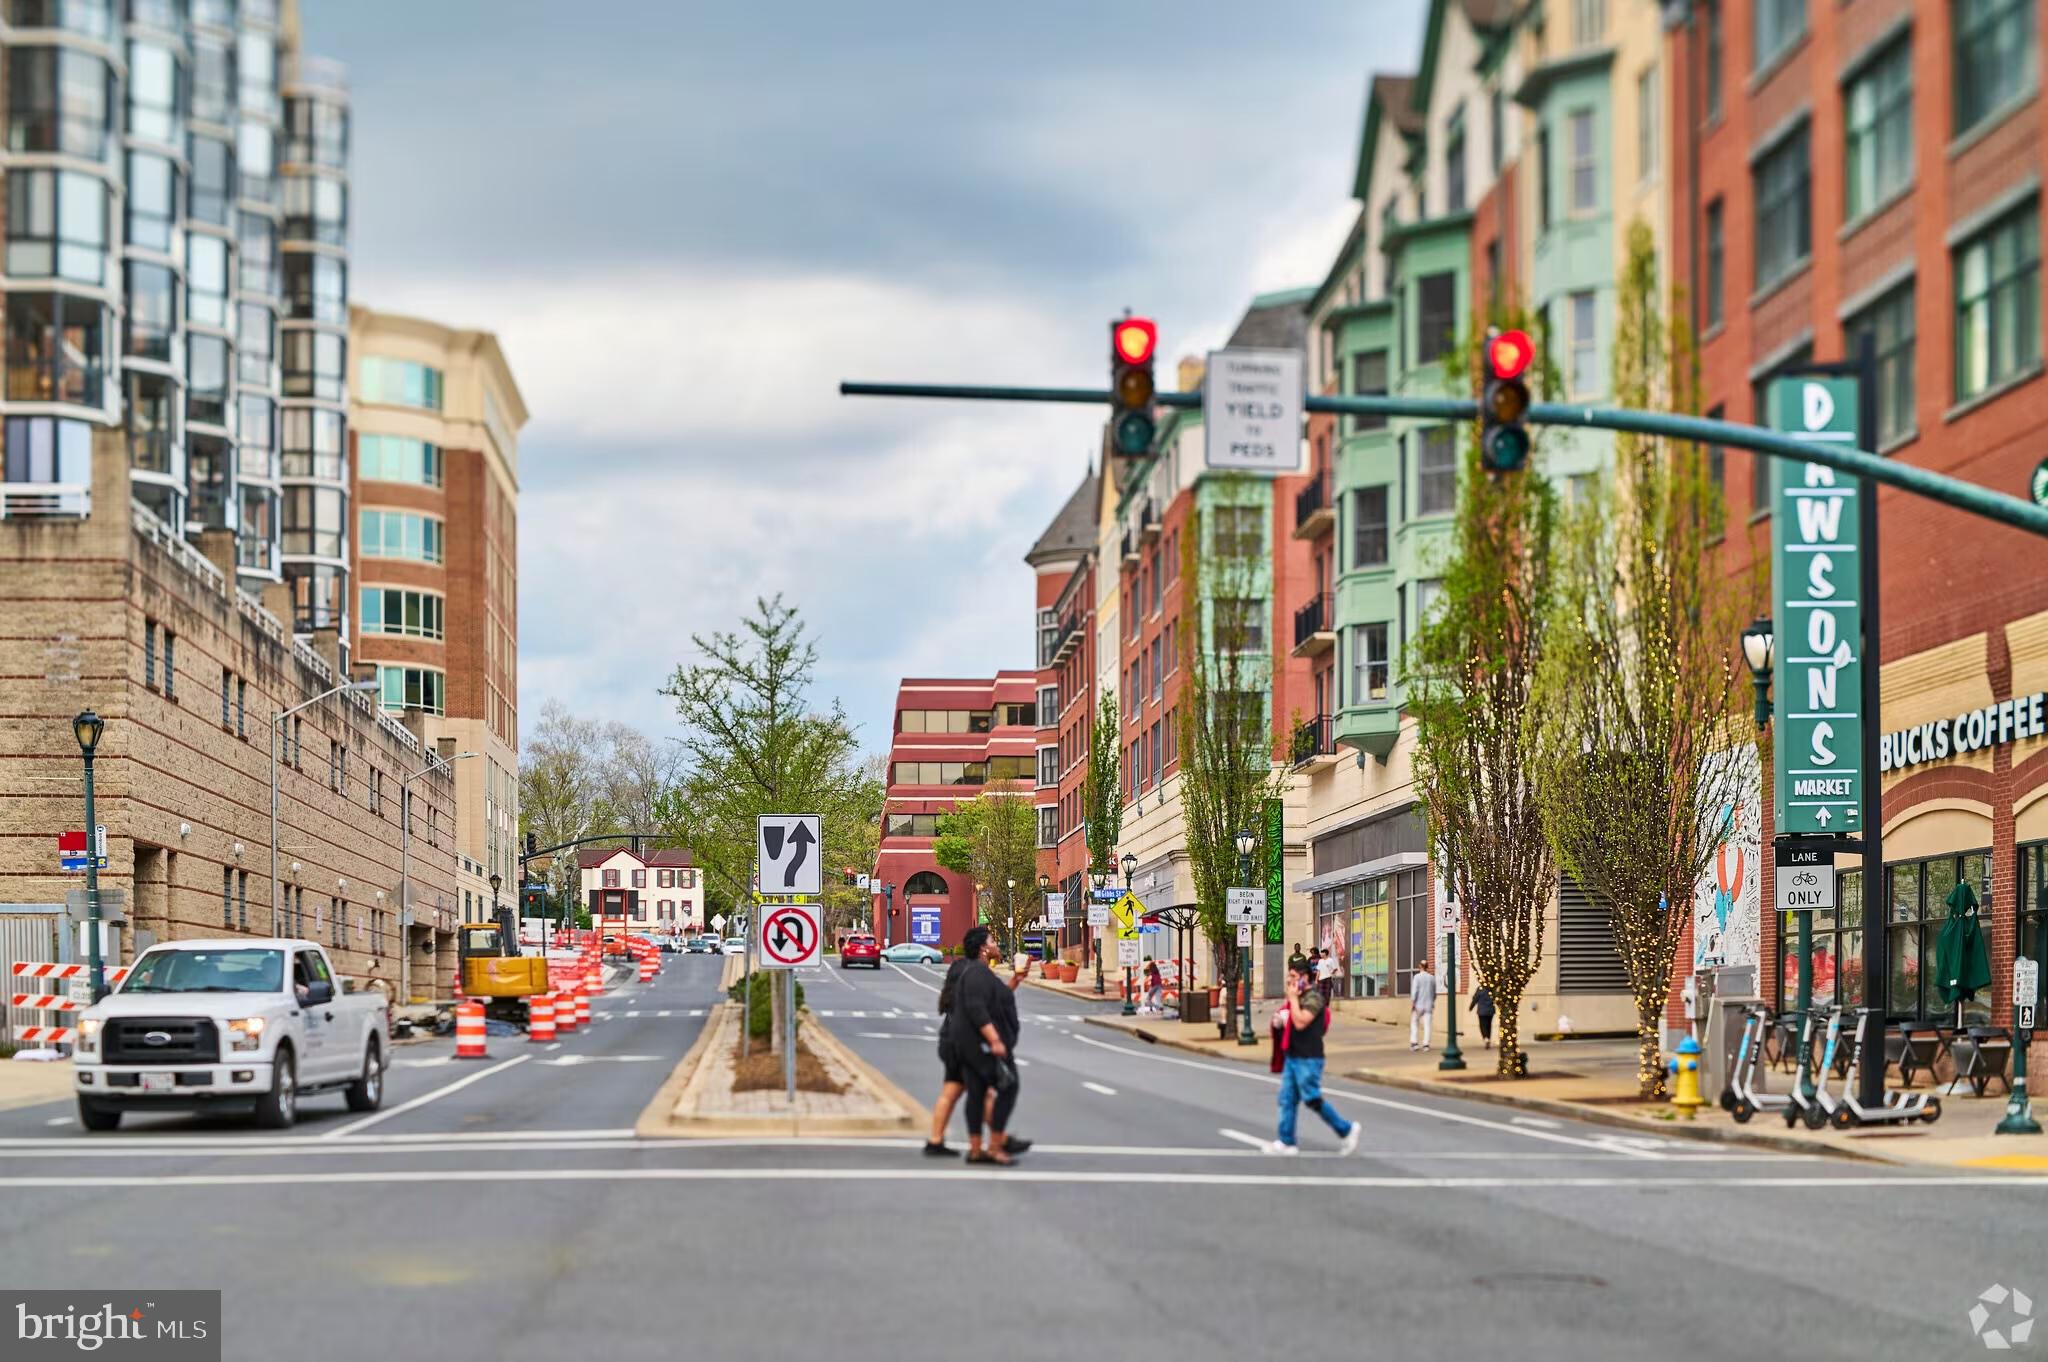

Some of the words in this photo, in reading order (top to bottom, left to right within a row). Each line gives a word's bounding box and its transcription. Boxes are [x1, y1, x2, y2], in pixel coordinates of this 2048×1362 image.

[1225, 402, 1284, 420] YIELD
[1230, 443, 1275, 457] PEDS
[1953, 692, 2044, 753] COFFEE
[1794, 778, 1853, 796] MARKET
[1791, 852, 1818, 862] LANE
[1788, 891, 1821, 905] ONLY
